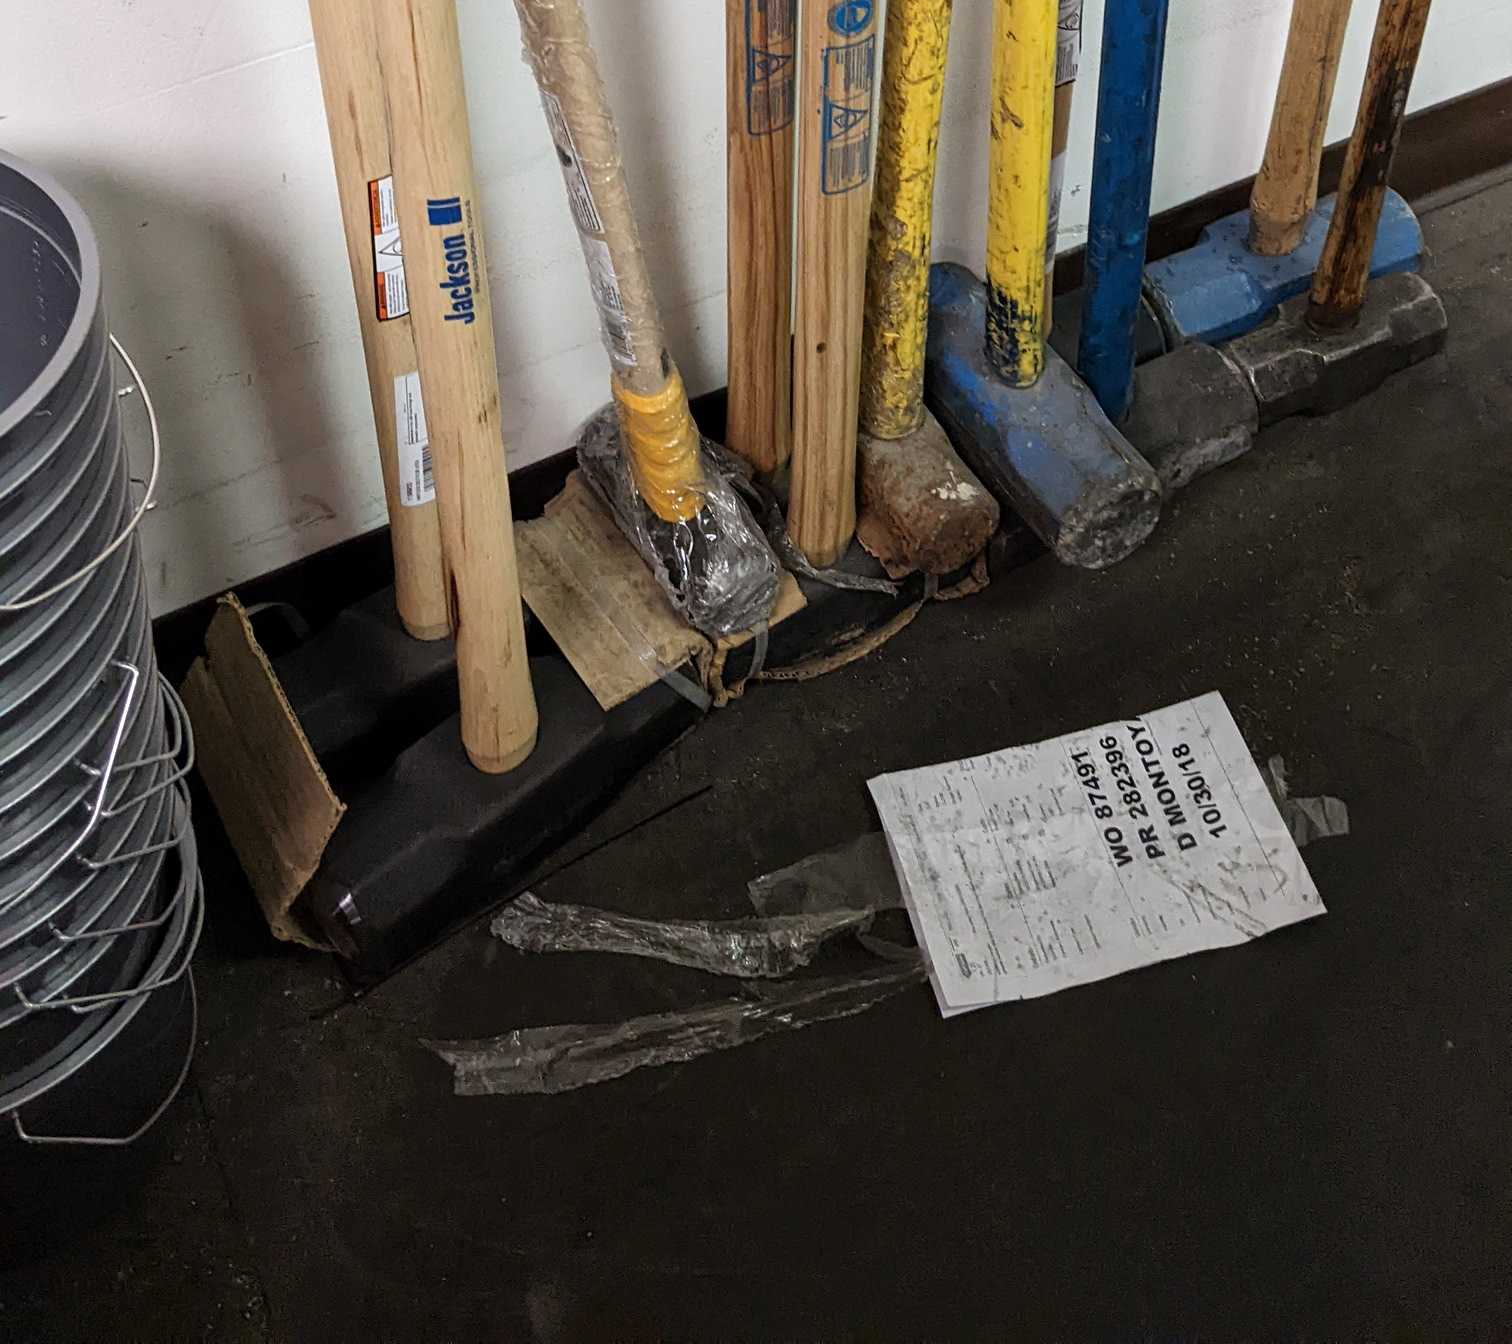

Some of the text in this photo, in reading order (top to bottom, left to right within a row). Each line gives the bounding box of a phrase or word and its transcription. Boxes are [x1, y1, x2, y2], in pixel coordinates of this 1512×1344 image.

[439, 233, 476, 324] Jackson
[1071, 751, 1133, 868] WO 87491
[1100, 736, 1166, 859] PR 282396
[1126, 717, 1198, 851] D MONTOY
[1172, 743, 1227, 838] 10/30/18
